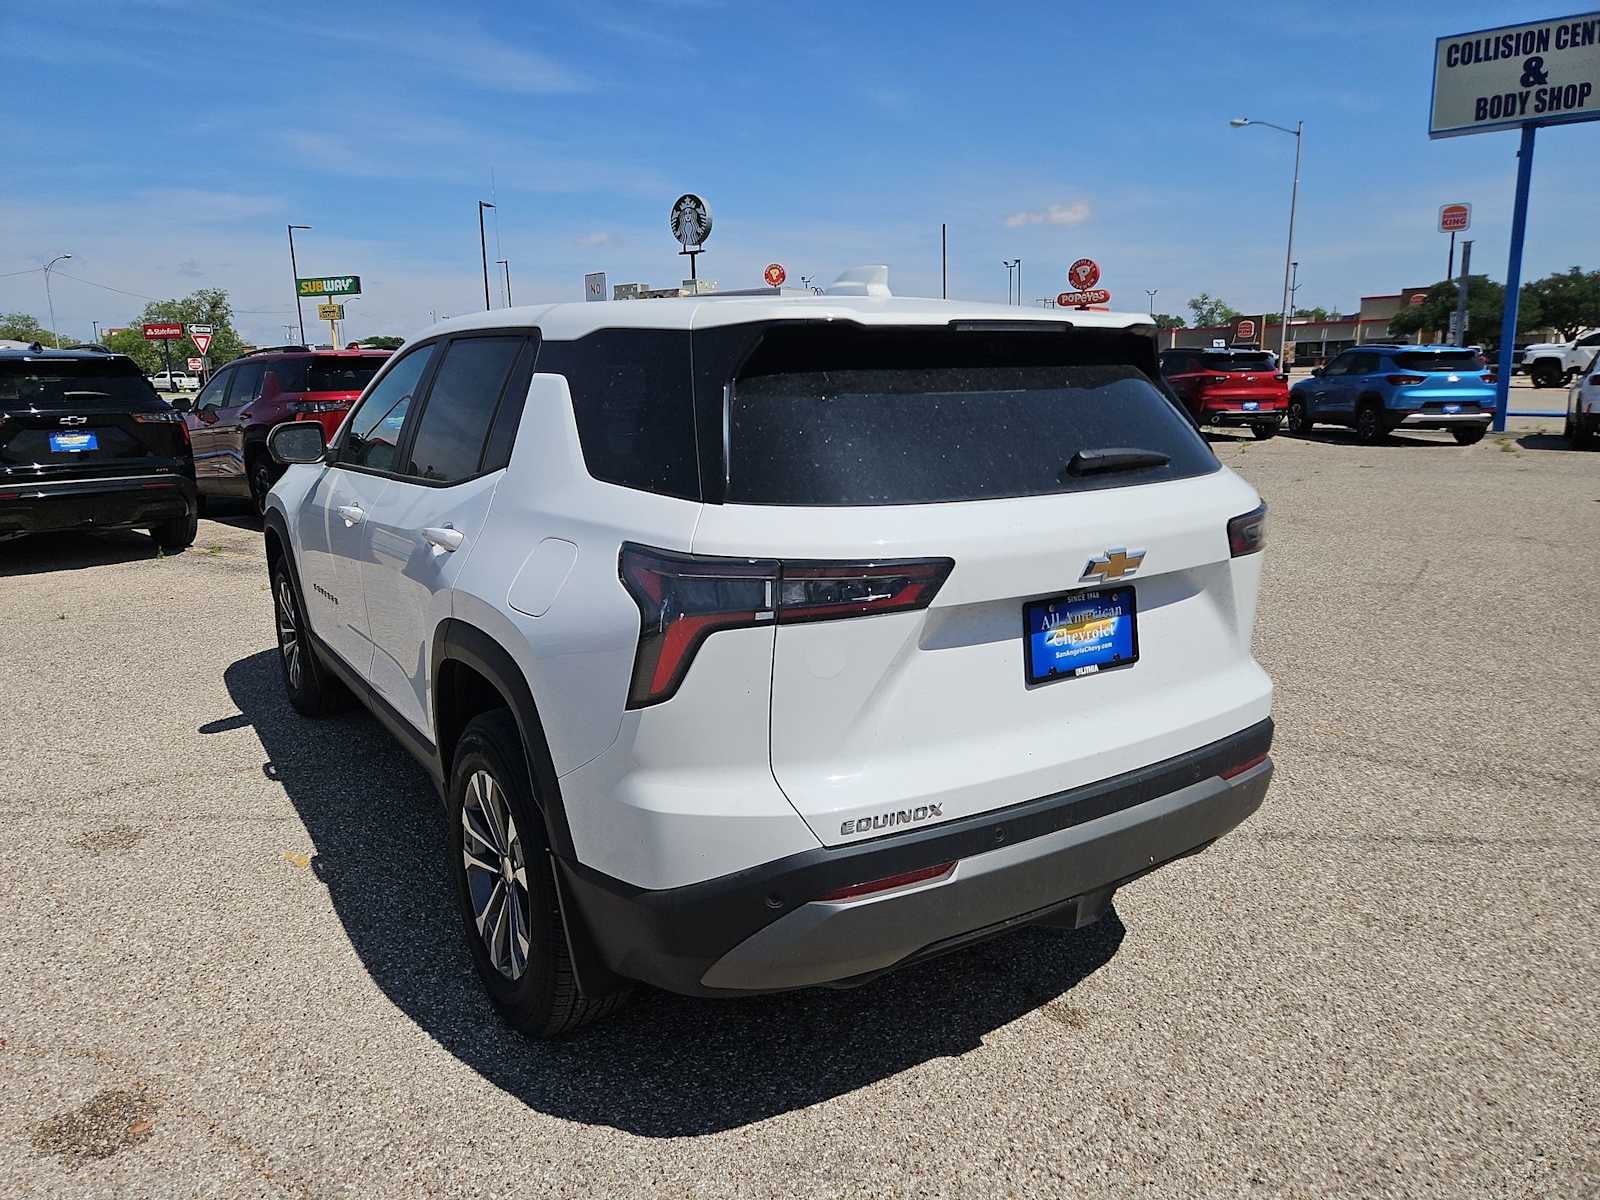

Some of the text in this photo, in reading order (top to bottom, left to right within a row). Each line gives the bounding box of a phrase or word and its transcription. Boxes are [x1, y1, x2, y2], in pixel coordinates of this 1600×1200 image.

[1447, 28, 1550, 68] COLLISION
[1520, 56, 1548, 88] &
[1475, 82, 1592, 121] BODY SHOP
[1442, 217, 1467, 226] KING
[301, 279, 352, 293] SUBWAY
[591, 283, 600, 295] NO
[1067, 593, 1086, 604] SINCE
[1041, 606, 1122, 630] All American
[1053, 623, 1115, 647] Chevrolet
[840, 802, 943, 835] EQUINOX
